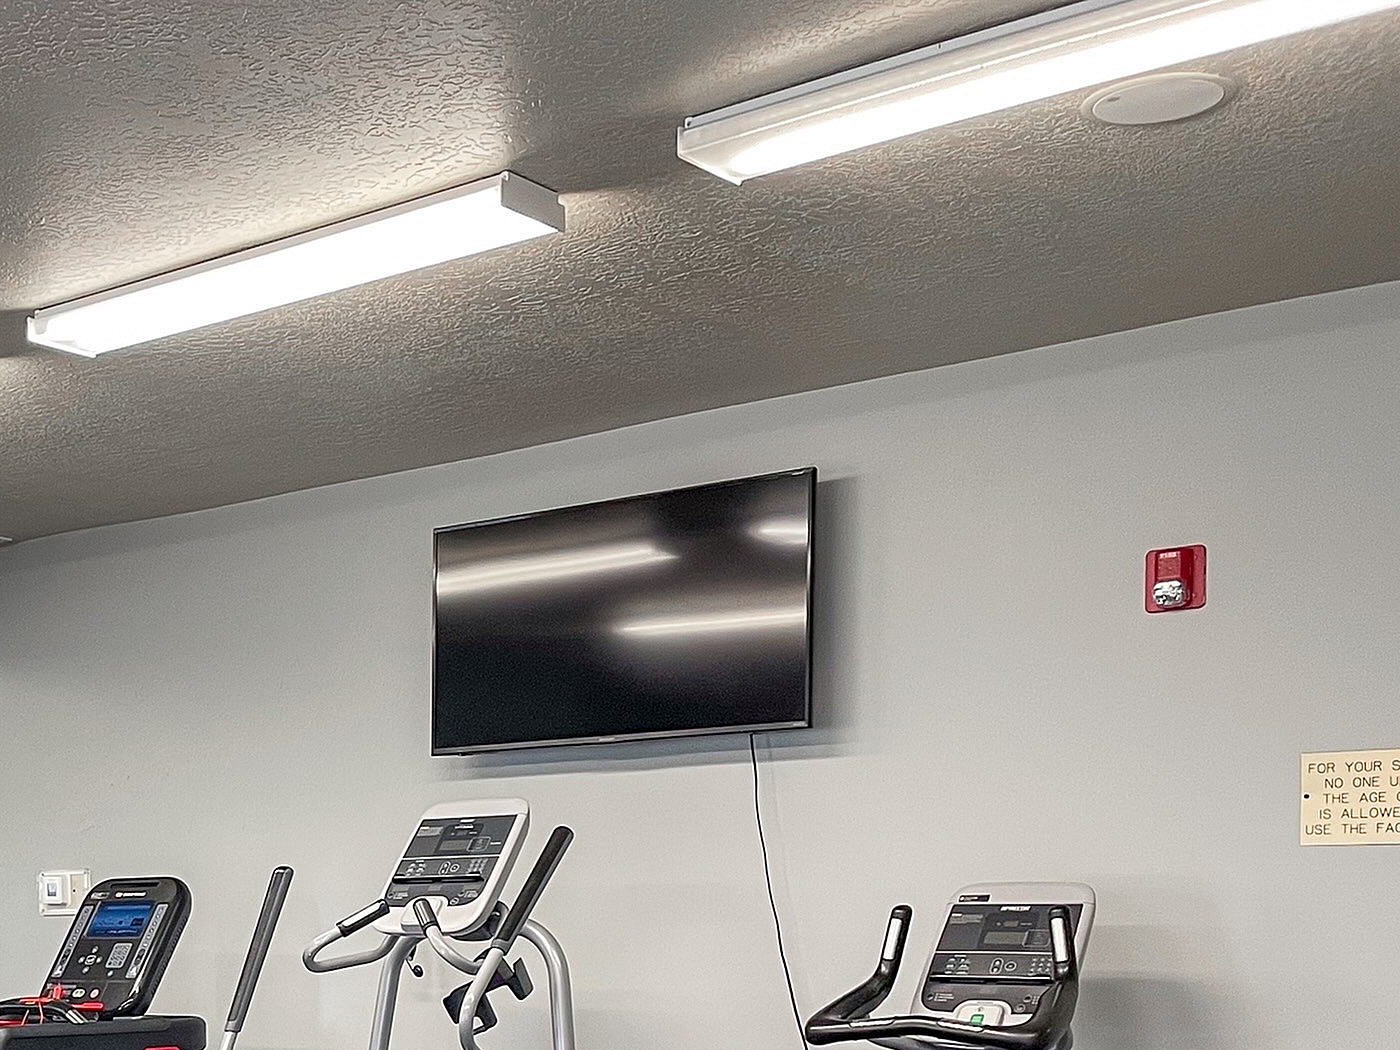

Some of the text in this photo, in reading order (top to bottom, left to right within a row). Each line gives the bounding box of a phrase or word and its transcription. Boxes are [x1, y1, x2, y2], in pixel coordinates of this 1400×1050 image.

[1308, 762, 1336, 774] FOR
[1345, 760, 1382, 773] YOUR
[1324, 777, 1344, 789] NO
[1352, 776, 1380, 788] ONE
[1323, 793, 1350, 804] THE
[1359, 791, 1387, 803] AGE
[1319, 808, 1332, 820] IS
[1305, 824, 1332, 835] USE
[1341, 823, 1367, 834] THE
